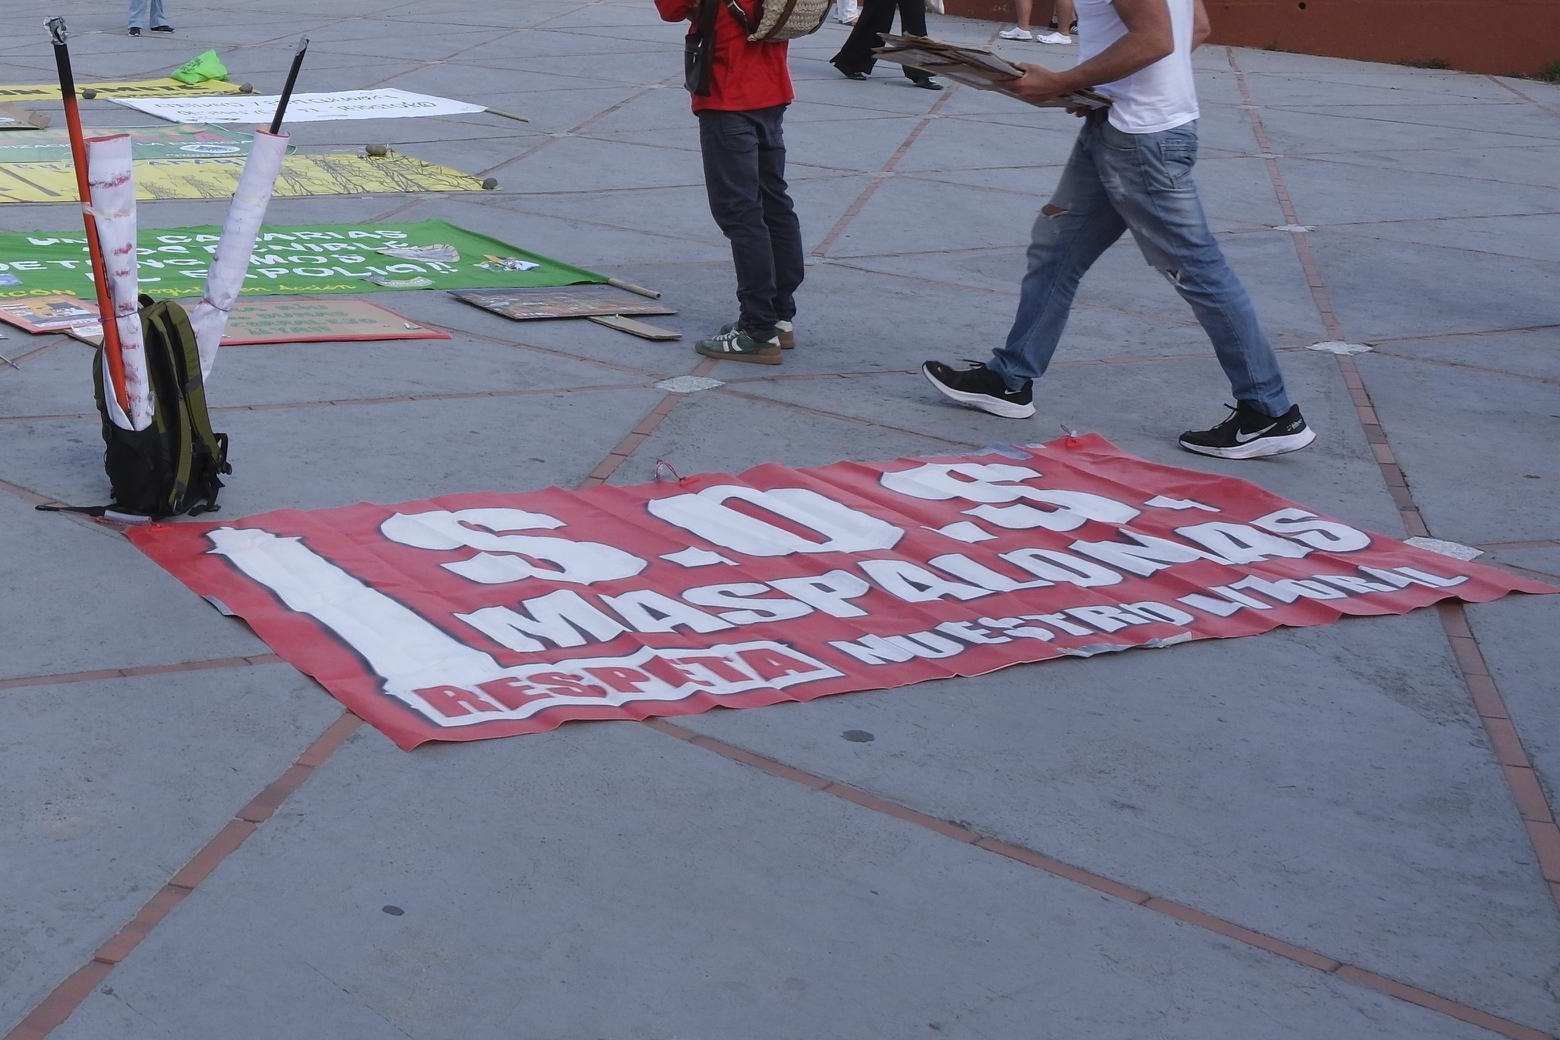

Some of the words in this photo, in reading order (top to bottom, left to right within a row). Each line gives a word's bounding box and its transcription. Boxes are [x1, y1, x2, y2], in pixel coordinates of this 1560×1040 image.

[157, 230, 407, 244] CAARIAS
[179, 262, 458, 279] EPOLIO!!
[454, 508, 1372, 653] MASPALOMAS
[411, 641, 835, 718] RESPETA
[828, 601, 1195, 666] NUESTRO
[1177, 565, 1469, 617] LITORAL
